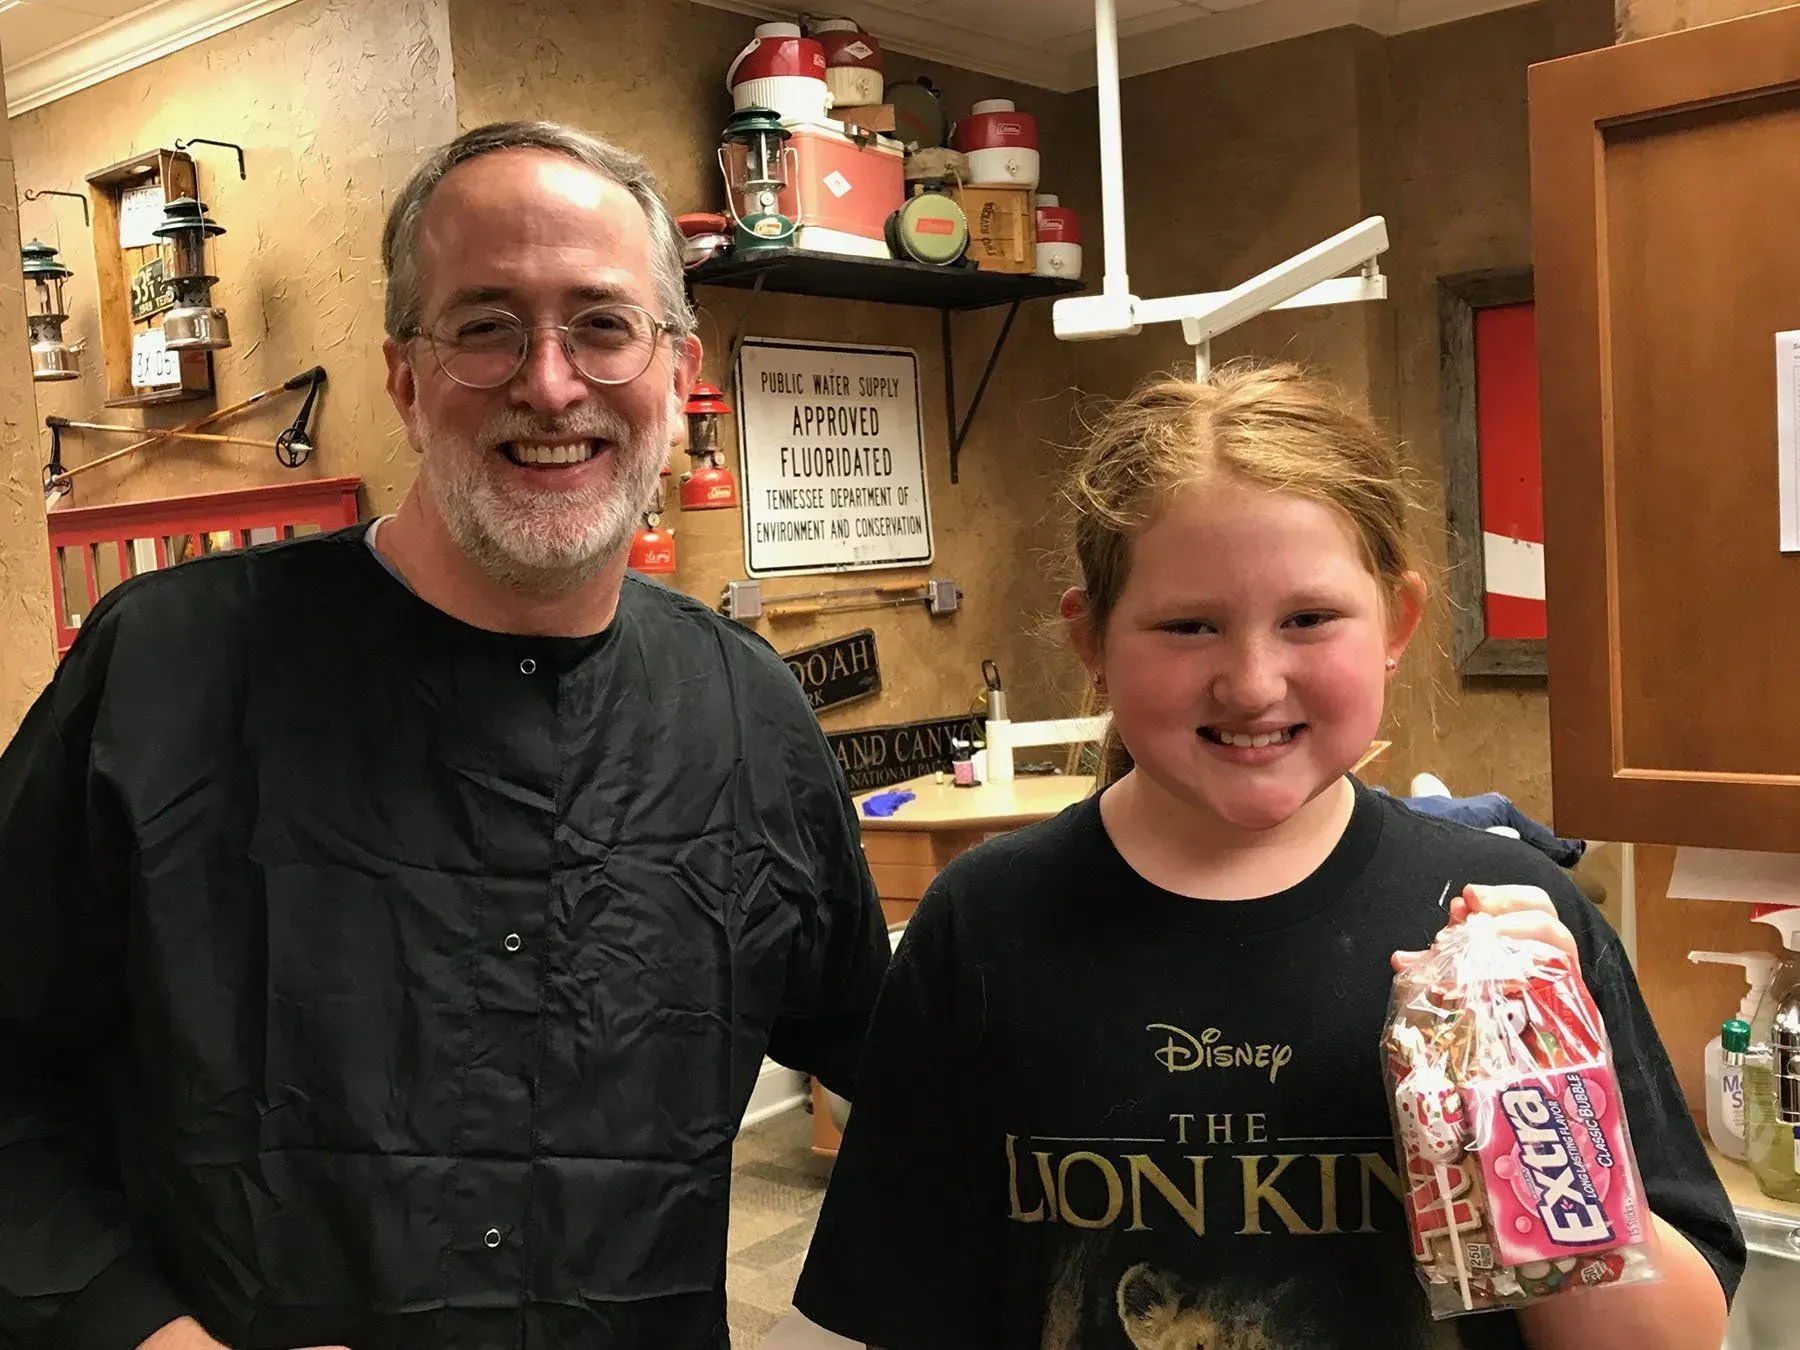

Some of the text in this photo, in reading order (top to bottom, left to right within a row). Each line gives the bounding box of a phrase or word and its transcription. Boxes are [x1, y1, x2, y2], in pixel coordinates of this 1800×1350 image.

[761, 371, 899, 398] PUBLIC WATER SUPPLY
[793, 405, 880, 437] APPROVED
[780, 447, 892, 478] FLUORIDATED
[766, 486, 909, 510] TENNESSEE DEPARTMENT OF
[757, 515, 922, 543] ENVIRONMENT AND CONSERVATION
[850, 765, 917, 787] NATIONAL
[1169, 1112, 1269, 1145] THE
[1566, 1073, 1614, 1168] CLASSIC BUBBLE
[1548, 1100, 1597, 1198] LONG LASTING FLAVOR
[1502, 1088, 1613, 1244] Extra
[1006, 1133, 1214, 1238] LION
[1467, 1244, 1482, 1268] 250
